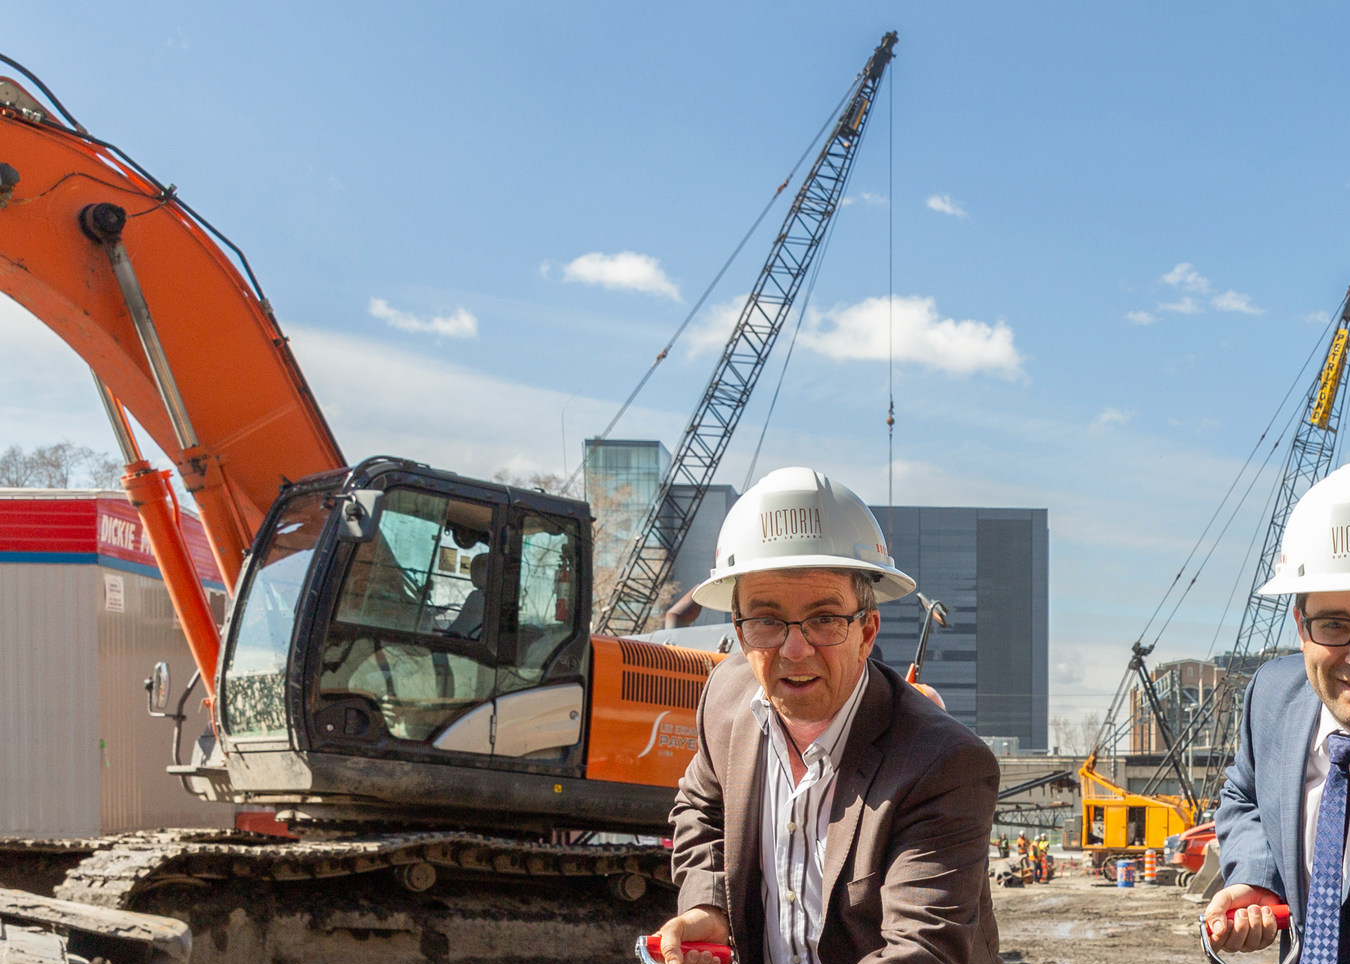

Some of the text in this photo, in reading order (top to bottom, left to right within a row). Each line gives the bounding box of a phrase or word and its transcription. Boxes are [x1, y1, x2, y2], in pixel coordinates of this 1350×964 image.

[1313, 333, 1345, 420] PETRIFOND
[100, 514, 136, 550] DICKIE
[760, 508, 823, 538] VICTORIA
